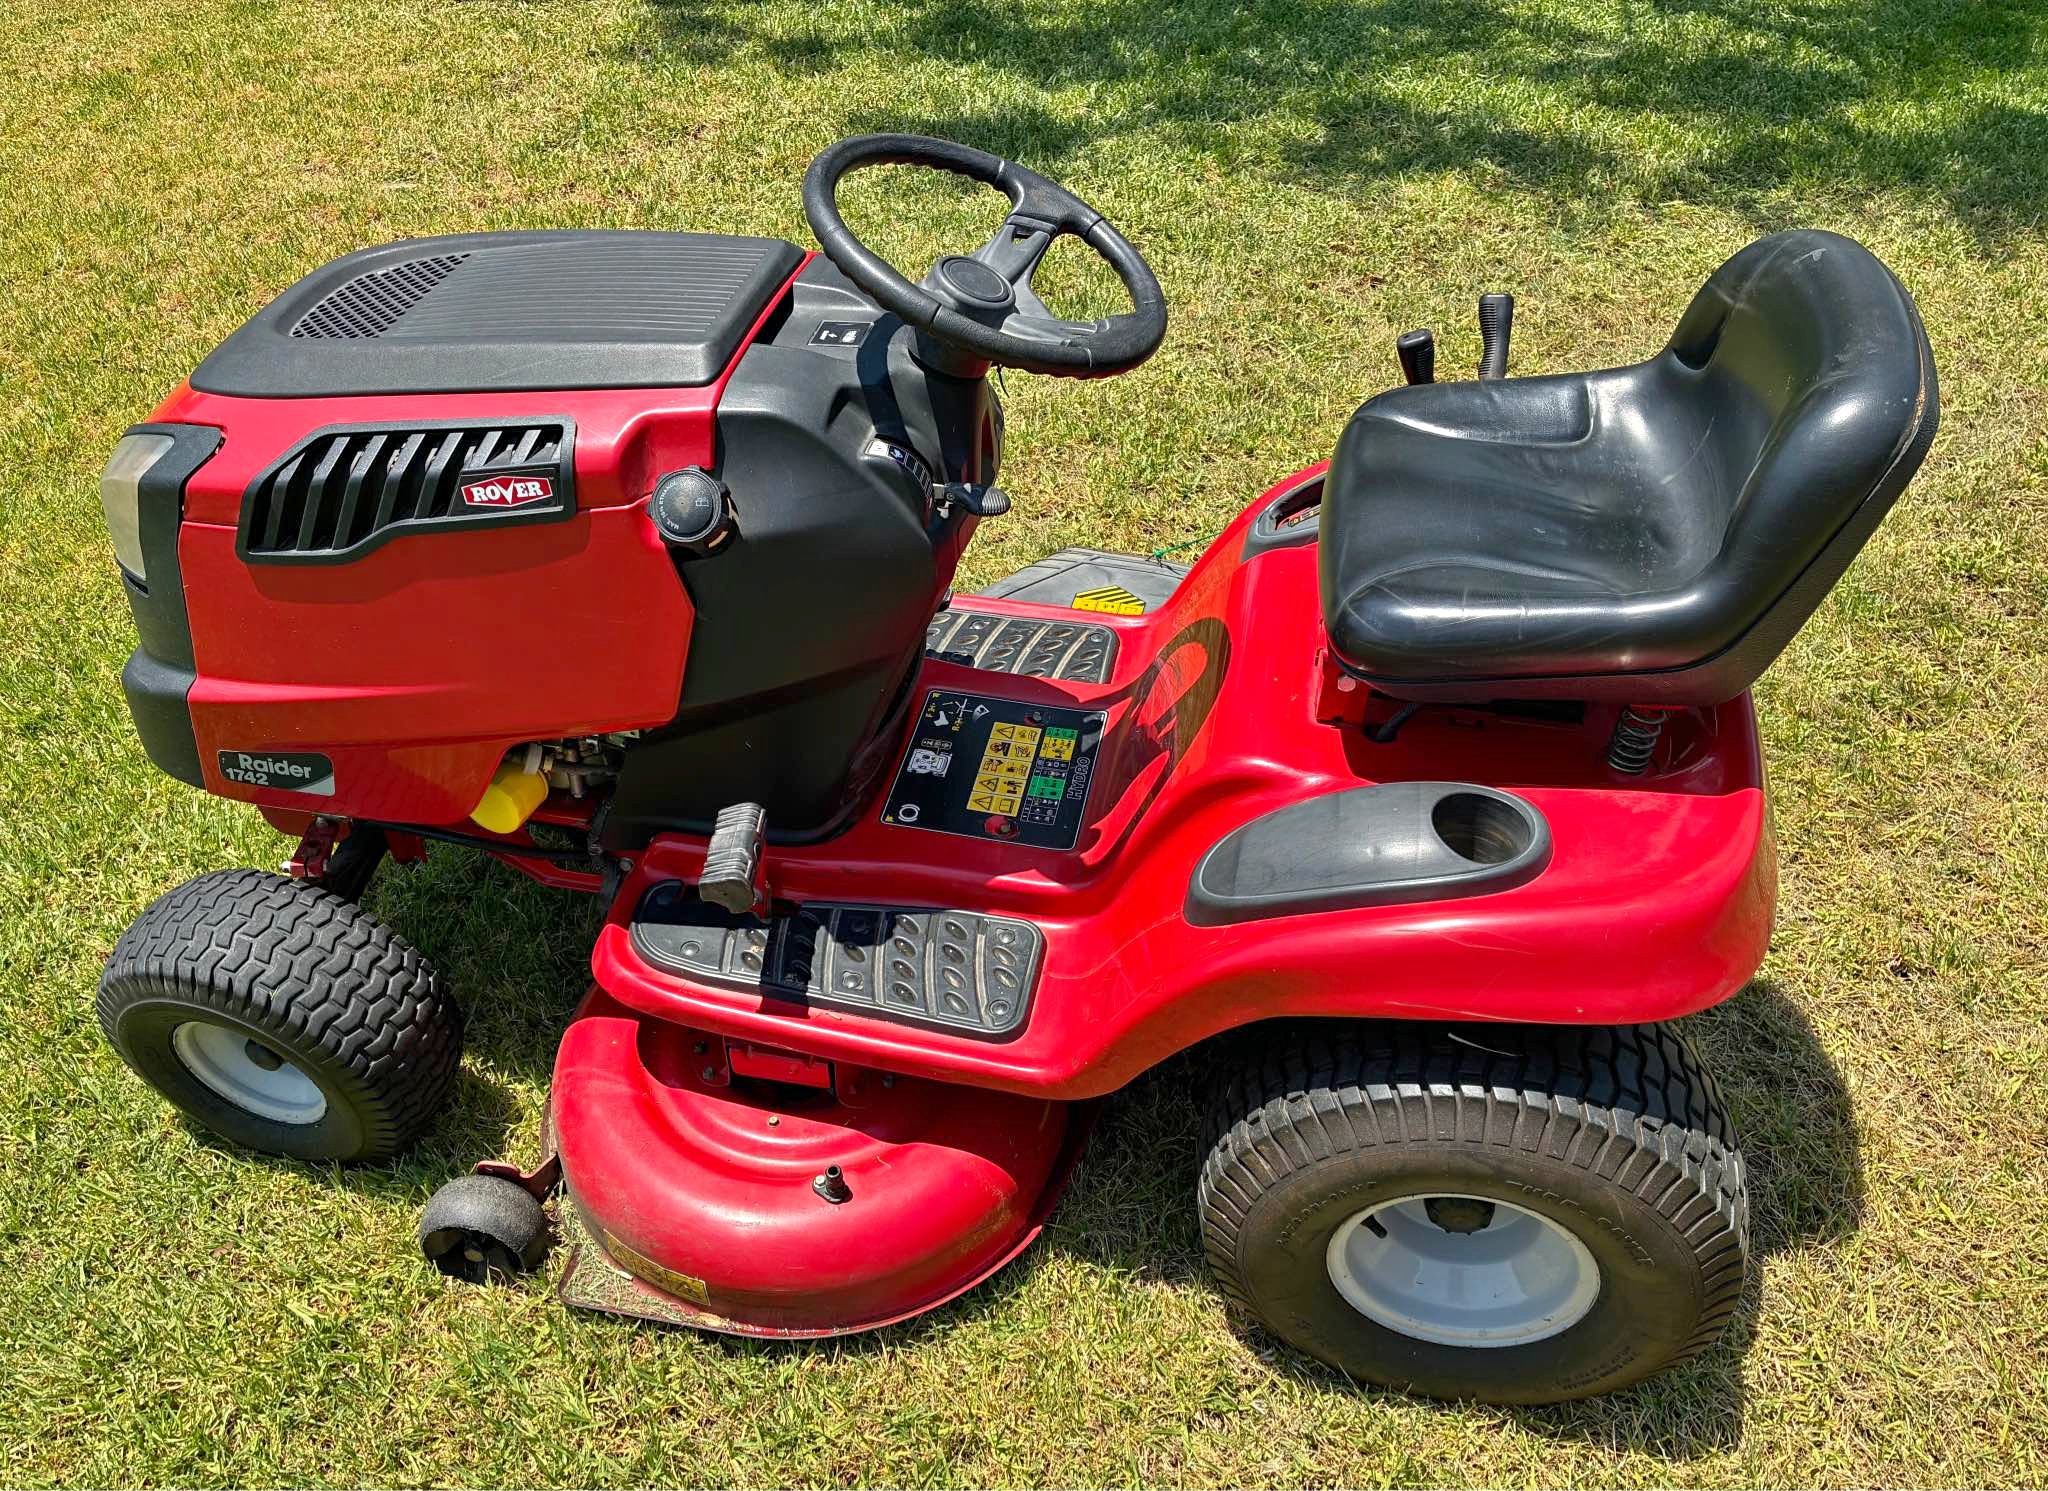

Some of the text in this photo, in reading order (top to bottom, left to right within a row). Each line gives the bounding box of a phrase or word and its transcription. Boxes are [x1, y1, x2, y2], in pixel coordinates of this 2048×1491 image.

[470, 479, 543, 504] ROVER
[226, 767, 269, 786] 1742
[238, 753, 311, 779] Raider
[1067, 757, 1091, 800] HYDRO
